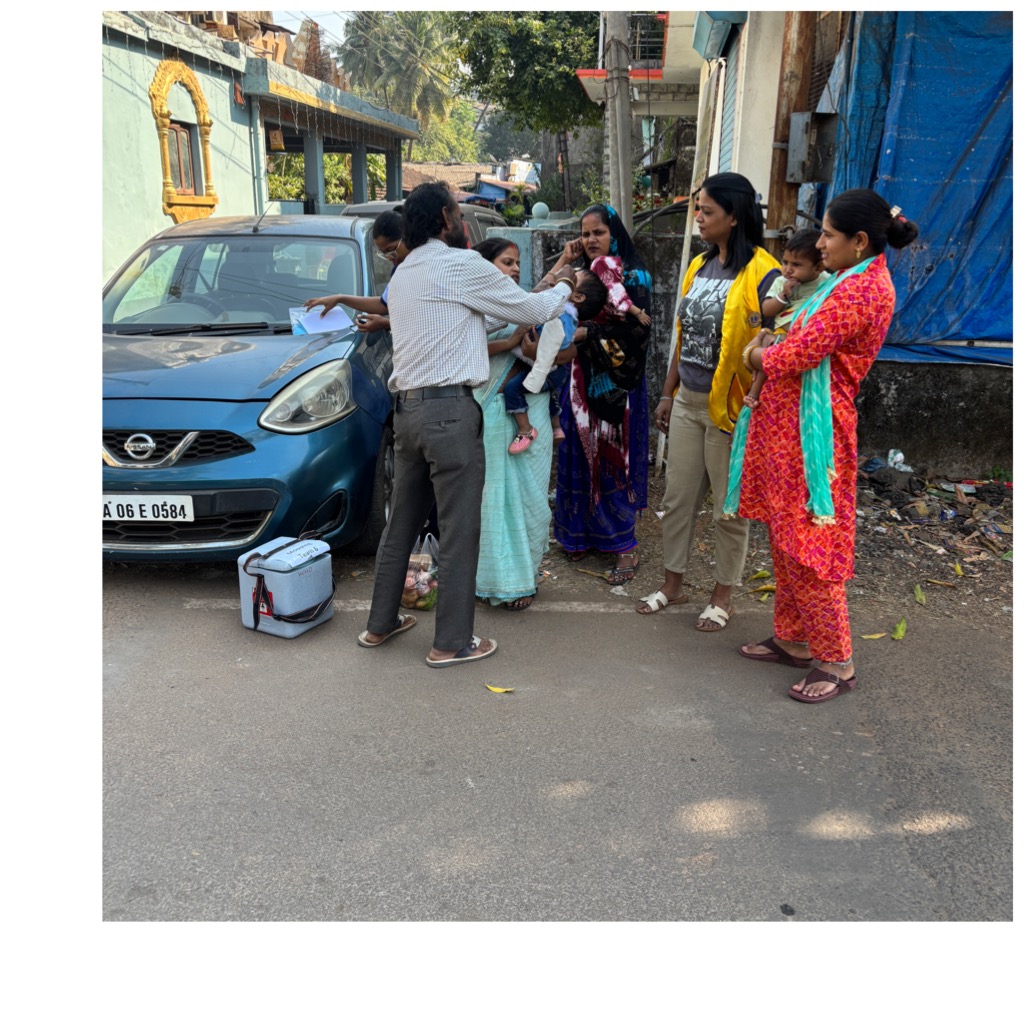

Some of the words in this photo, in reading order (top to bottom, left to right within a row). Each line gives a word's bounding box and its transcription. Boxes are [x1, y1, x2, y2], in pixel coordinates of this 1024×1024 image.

[103, 504, 112, 518] A
[116, 503, 134, 518] 06
[138, 504, 147, 518] E
[151, 503, 187, 519] 0584
